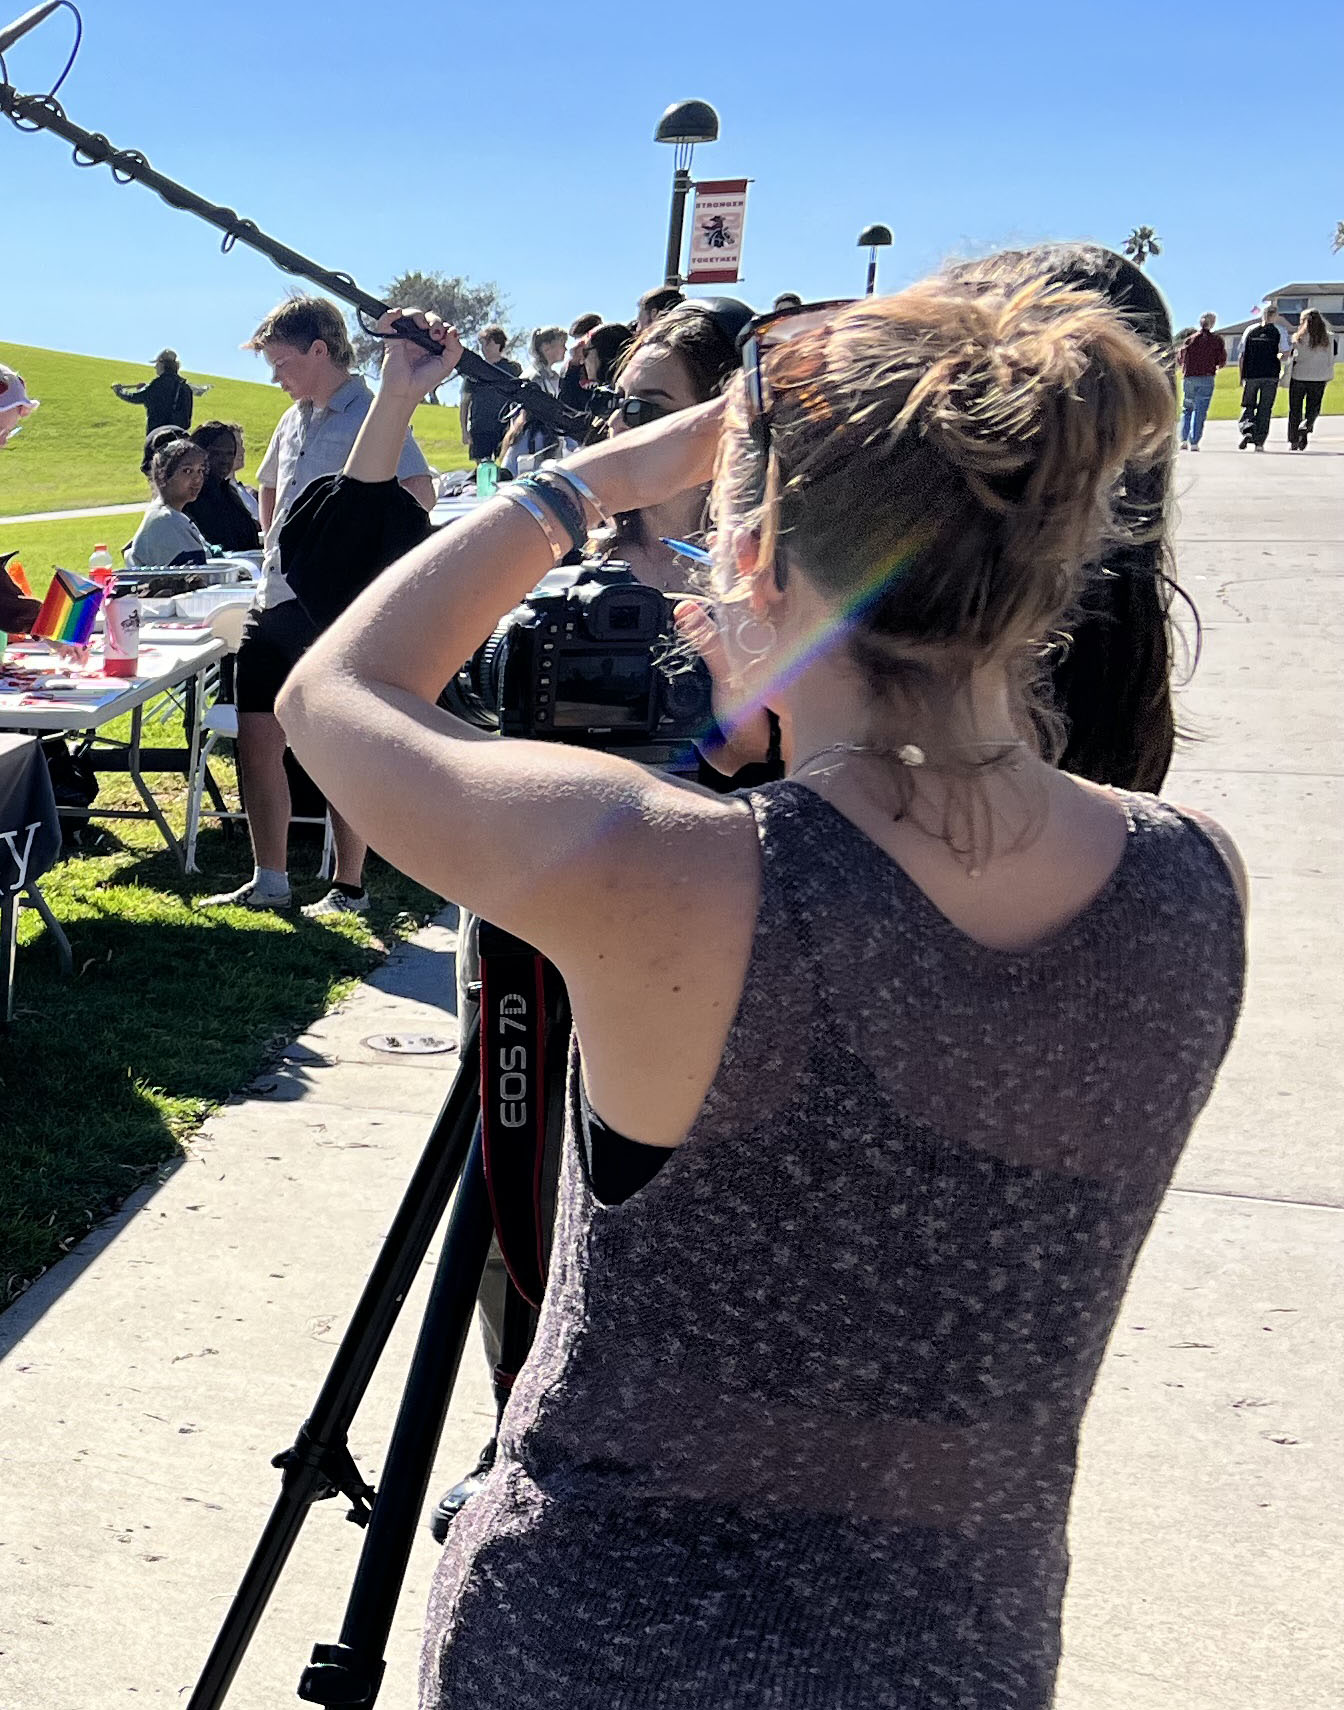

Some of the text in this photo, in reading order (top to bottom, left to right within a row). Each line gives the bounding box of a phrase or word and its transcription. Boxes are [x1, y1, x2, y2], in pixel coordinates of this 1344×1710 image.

[696, 200, 744, 209] STRONGER
[692, 256, 737, 264] TOGETHER
[499, 993, 527, 1128] EOS 7D
